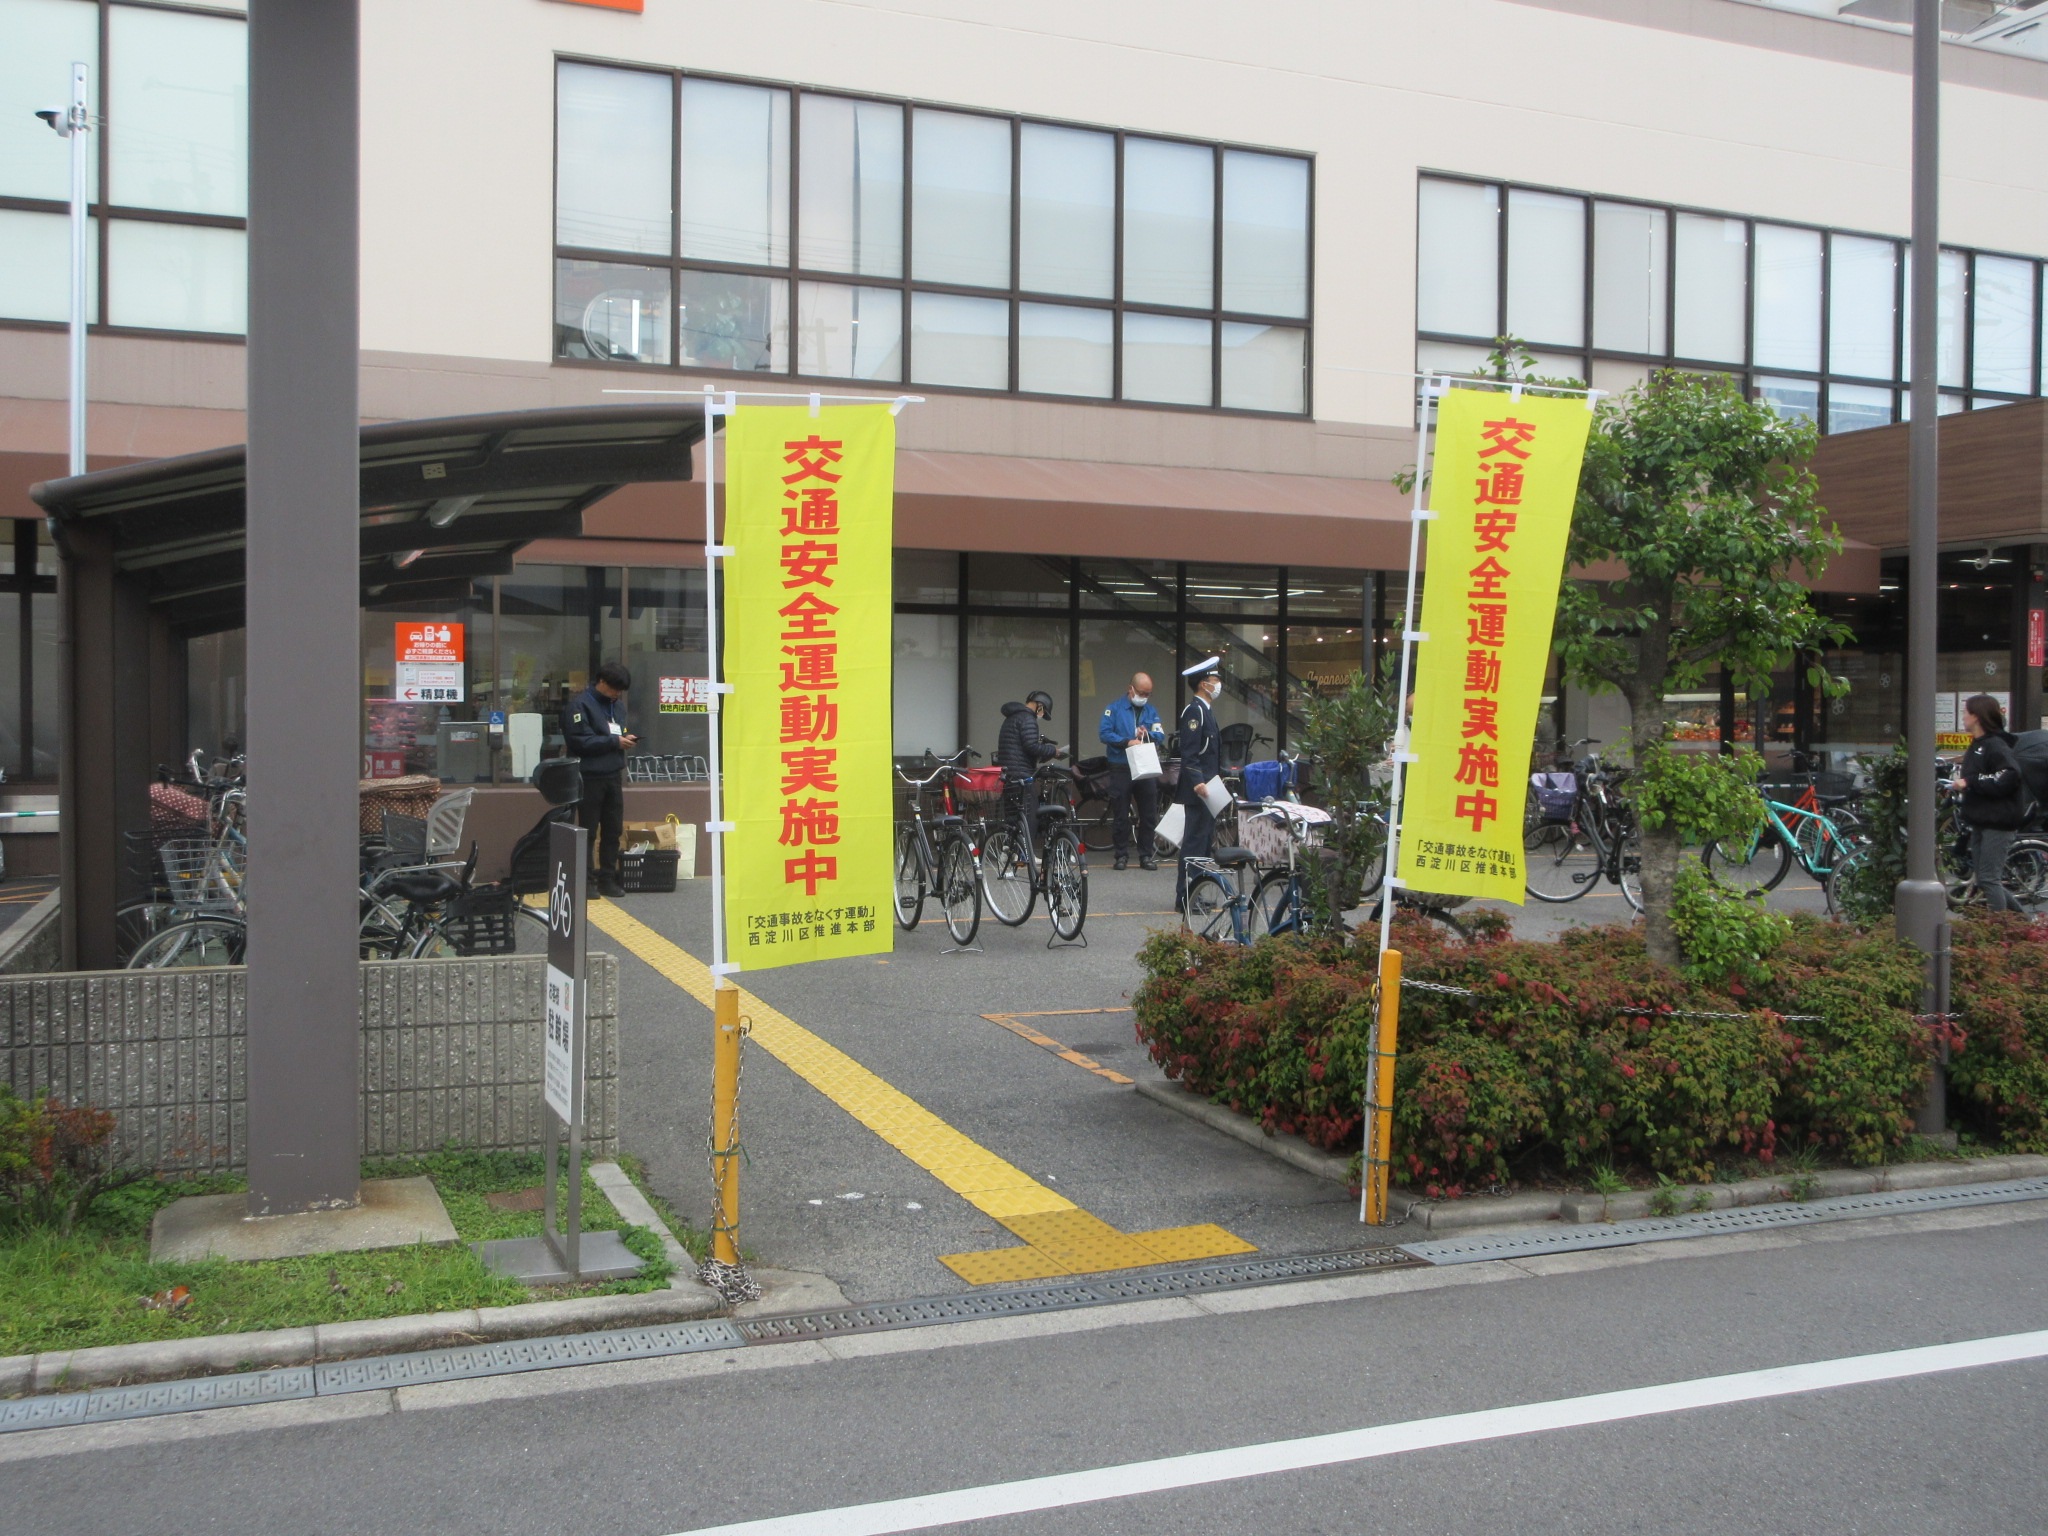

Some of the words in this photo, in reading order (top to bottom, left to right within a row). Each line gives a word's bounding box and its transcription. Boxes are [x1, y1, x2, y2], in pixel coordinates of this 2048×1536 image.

[1455, 418, 1536, 832] 交通安全運動実施中
[779, 435, 843, 896] 交通安全運動実施中
[420, 688, 458, 700] 精算機
[661, 678, 709, 703] 禁煙
[1417, 839, 1515, 866] 「交通事故をなくす運動」
[1416, 854, 1517, 879] 西淀川区推進本部
[747, 905, 876, 929] 「交通事故をなくす運動」
[748, 919, 876, 947] 西淀川区推進本部
